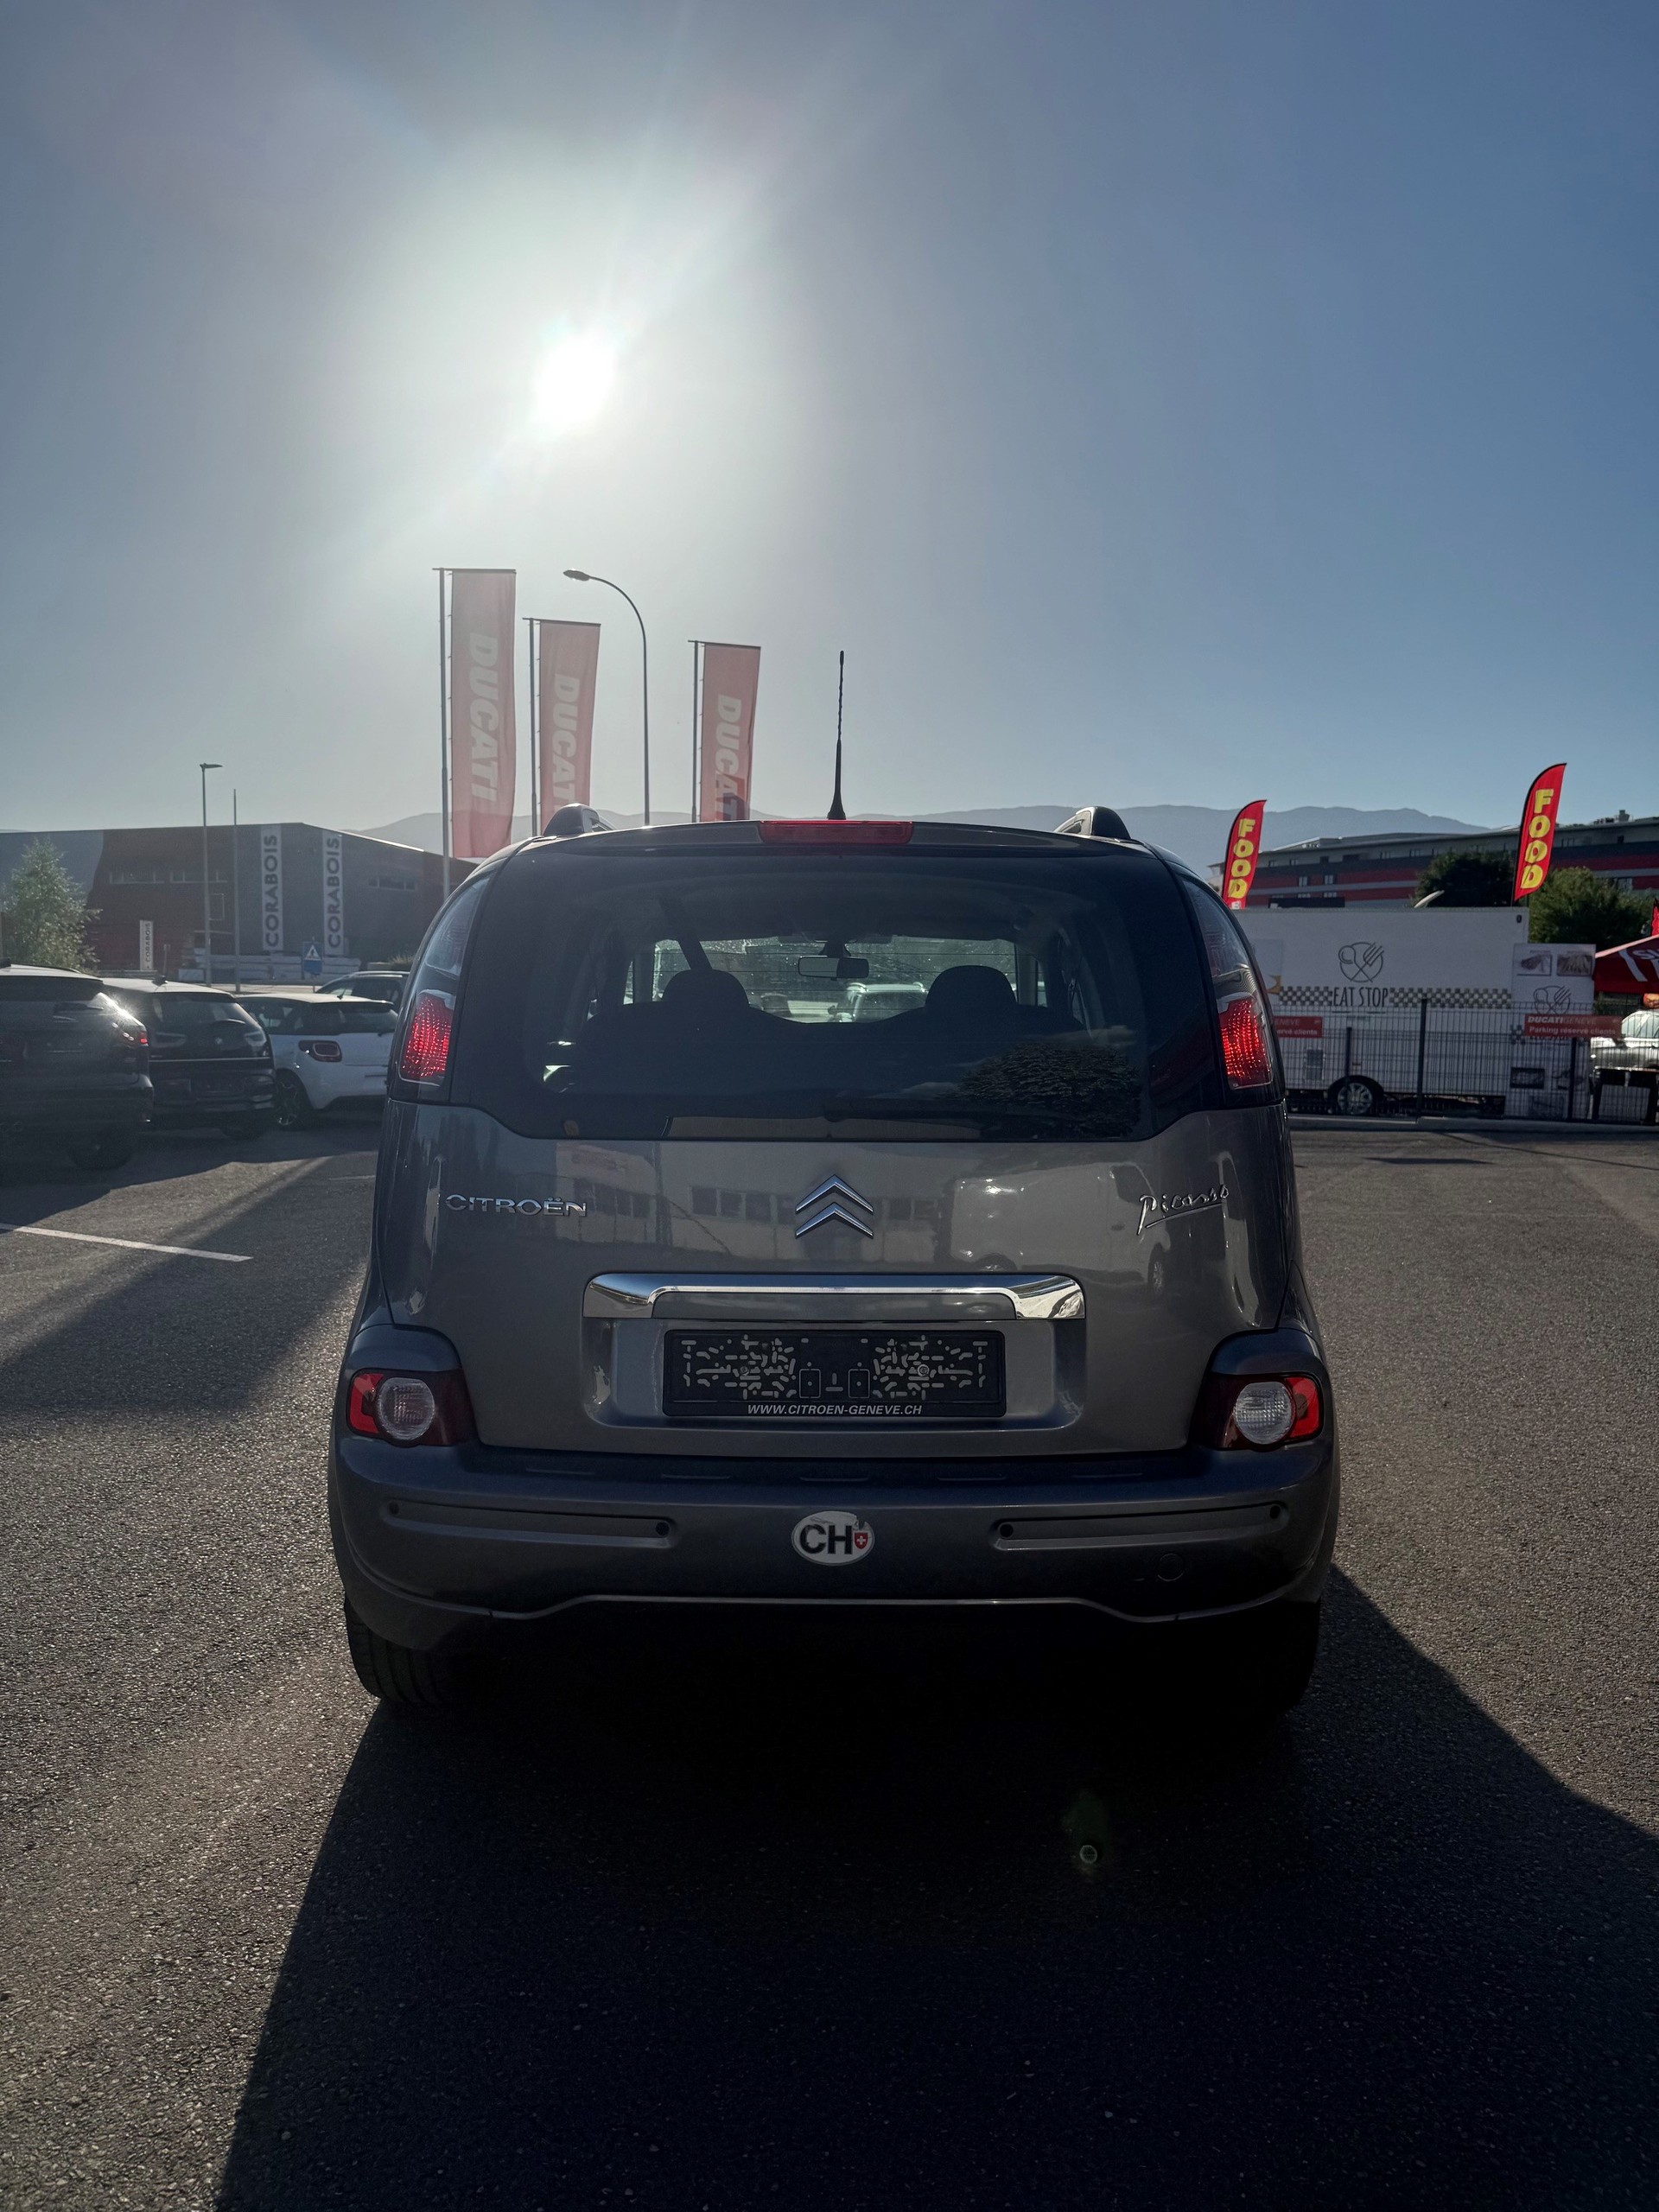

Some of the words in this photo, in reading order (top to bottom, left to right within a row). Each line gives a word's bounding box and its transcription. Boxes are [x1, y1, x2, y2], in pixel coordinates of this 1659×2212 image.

[469, 632, 499, 802] DUCATI
[552, 674, 580, 813] DUCAT
[715, 695, 742, 821] DUCAT
[1228, 818, 1256, 899] FOOD
[1521, 789, 1554, 889] FOOD
[264, 835, 279, 947] CORABOIS
[326, 837, 341, 948] CORABOIS
[1333, 987, 1357, 1007] EAT
[1358, 987, 1389, 1007] STOP
[1529, 1027, 1559, 1035] Parking
[446, 1194, 588, 1217] CITROËN
[747, 1404, 922, 1414] WWW.CITROEN-GENEVE.CH
[800, 1525, 852, 1554] CH
